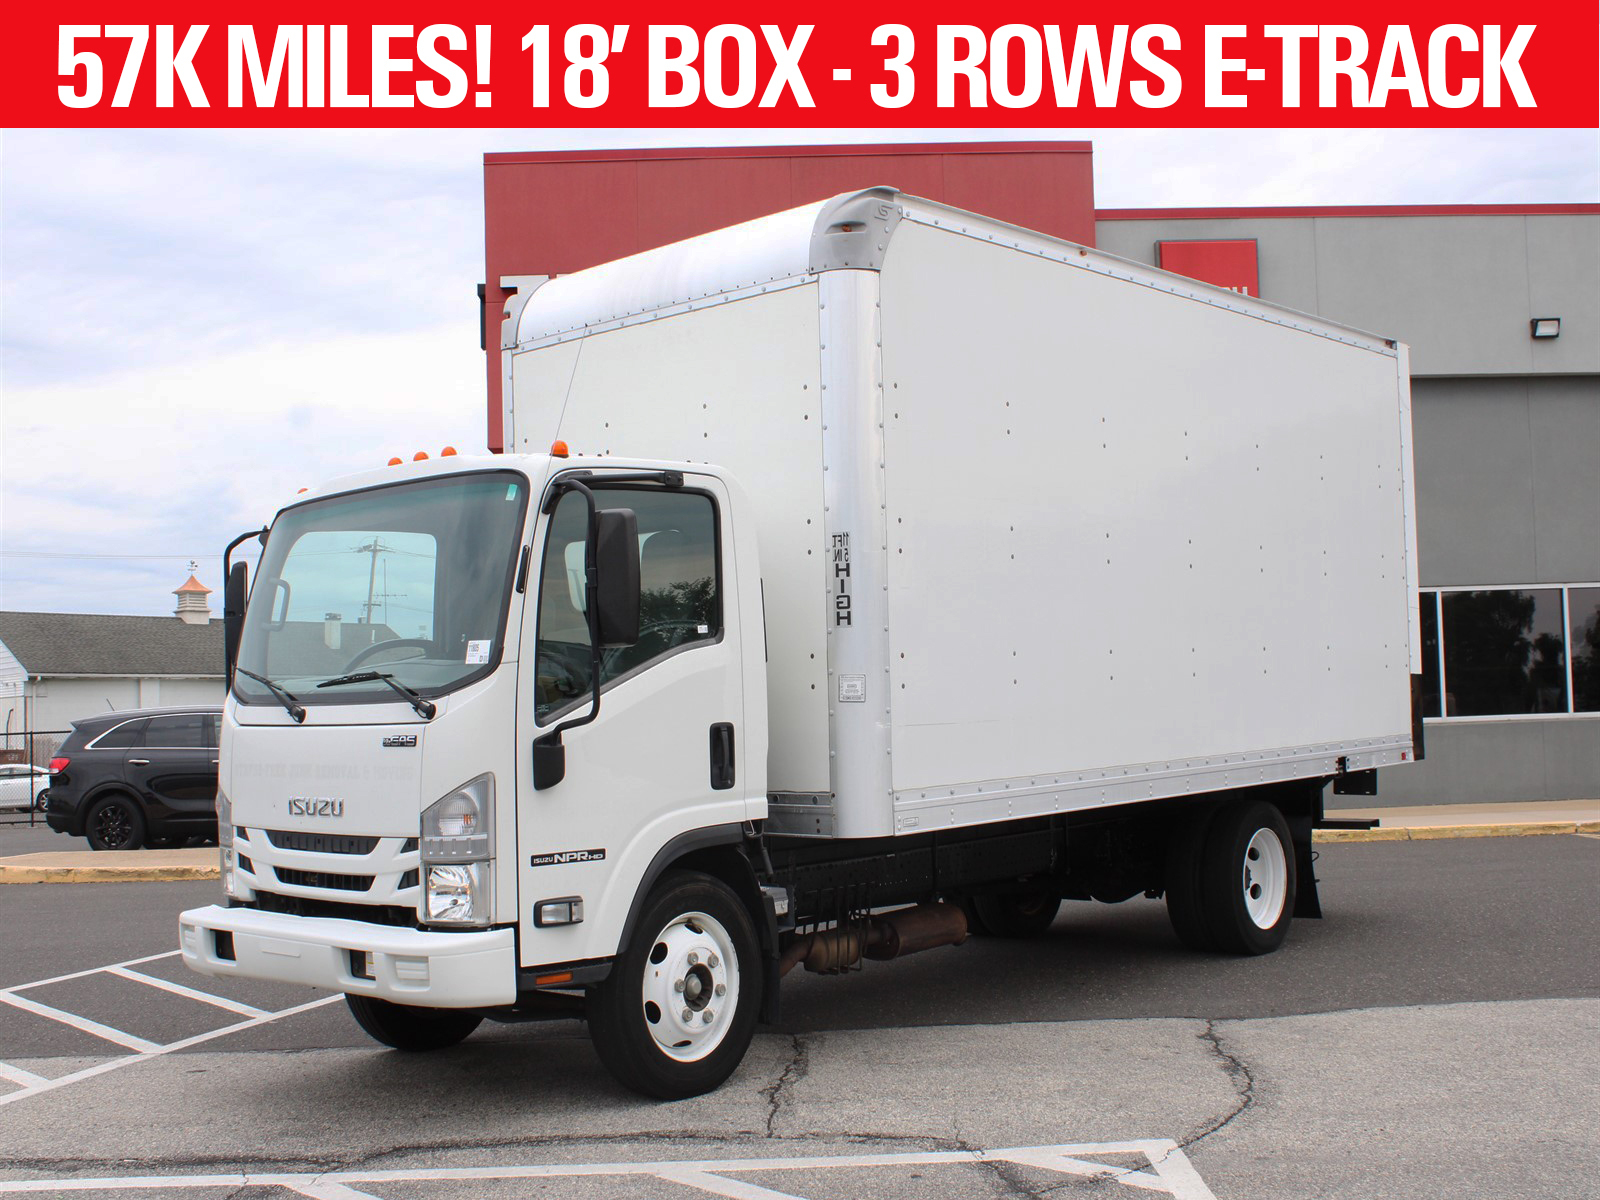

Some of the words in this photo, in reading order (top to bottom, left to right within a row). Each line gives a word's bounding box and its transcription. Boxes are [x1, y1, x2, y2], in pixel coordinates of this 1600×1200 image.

[288, 796, 344, 817] ISUZU
[533, 856, 553, 864] ISUZU
[553, 851, 588, 863] NPR
